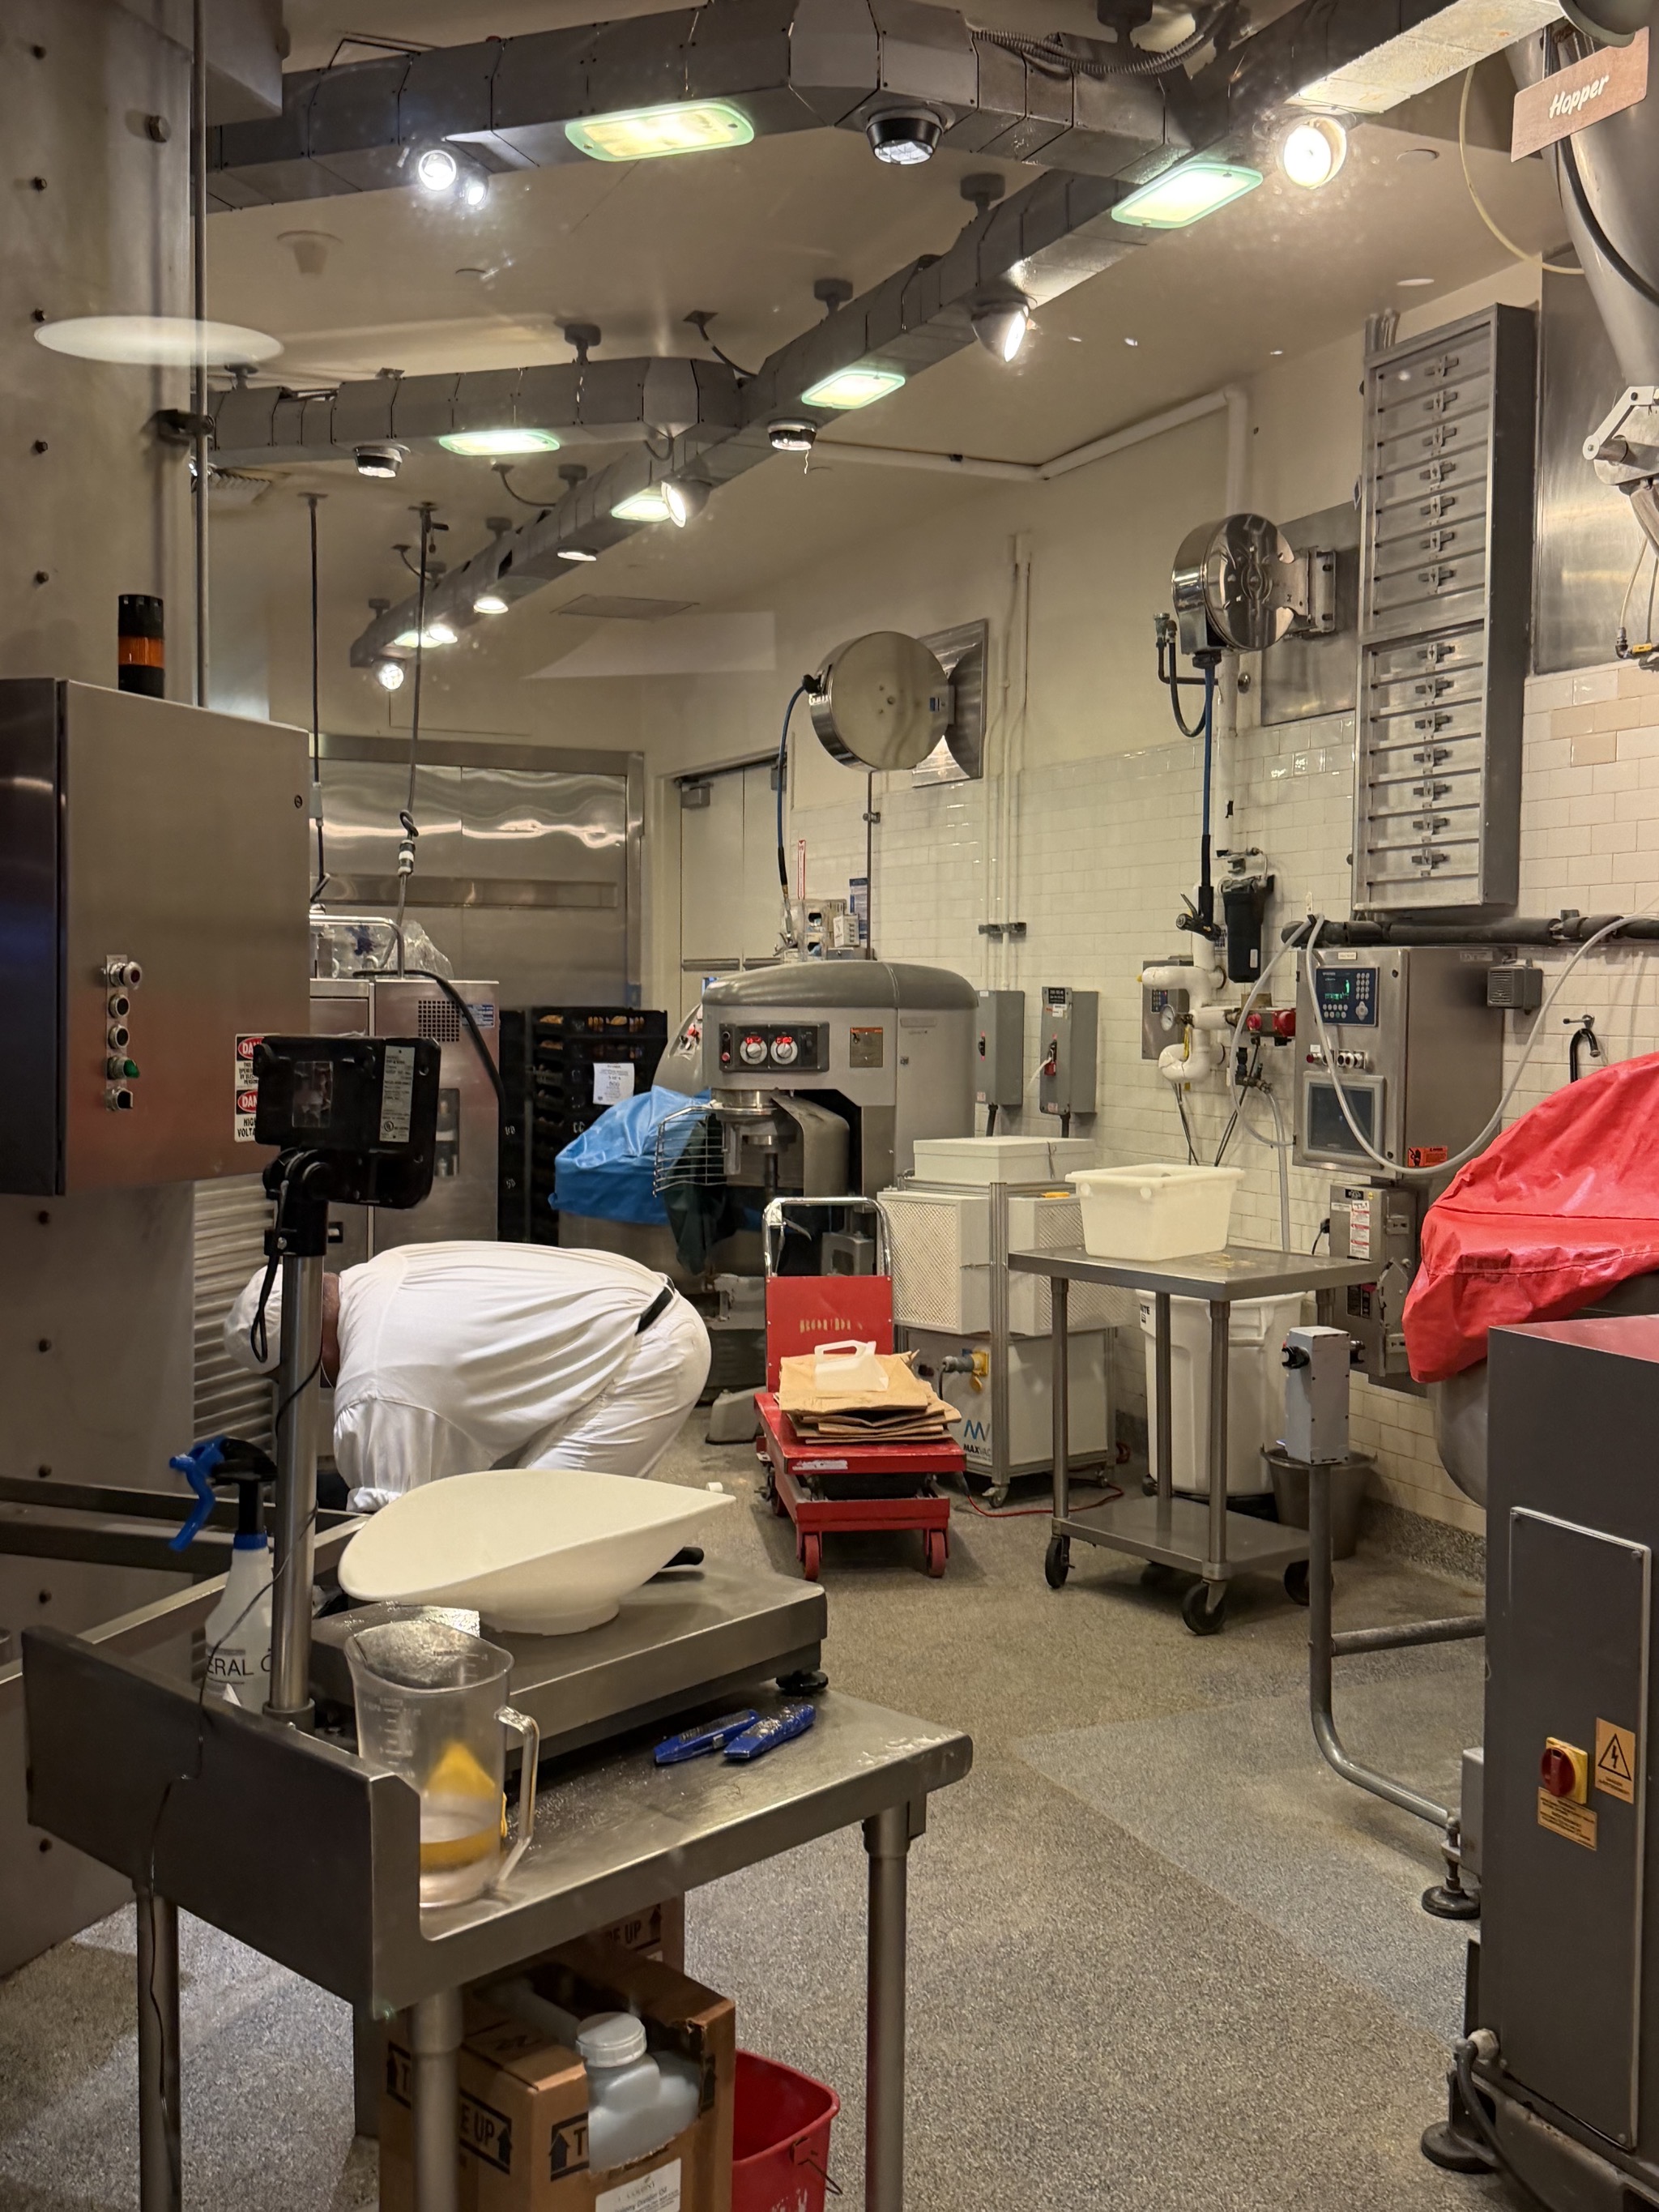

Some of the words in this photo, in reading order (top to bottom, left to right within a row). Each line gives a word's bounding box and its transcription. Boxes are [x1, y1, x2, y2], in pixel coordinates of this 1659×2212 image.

[1549, 75, 1610, 119] Hopper
[207, 1656, 254, 1676] ERAL
[625, 1919, 642, 1944] UP
[473, 2111, 495, 2146] UP
